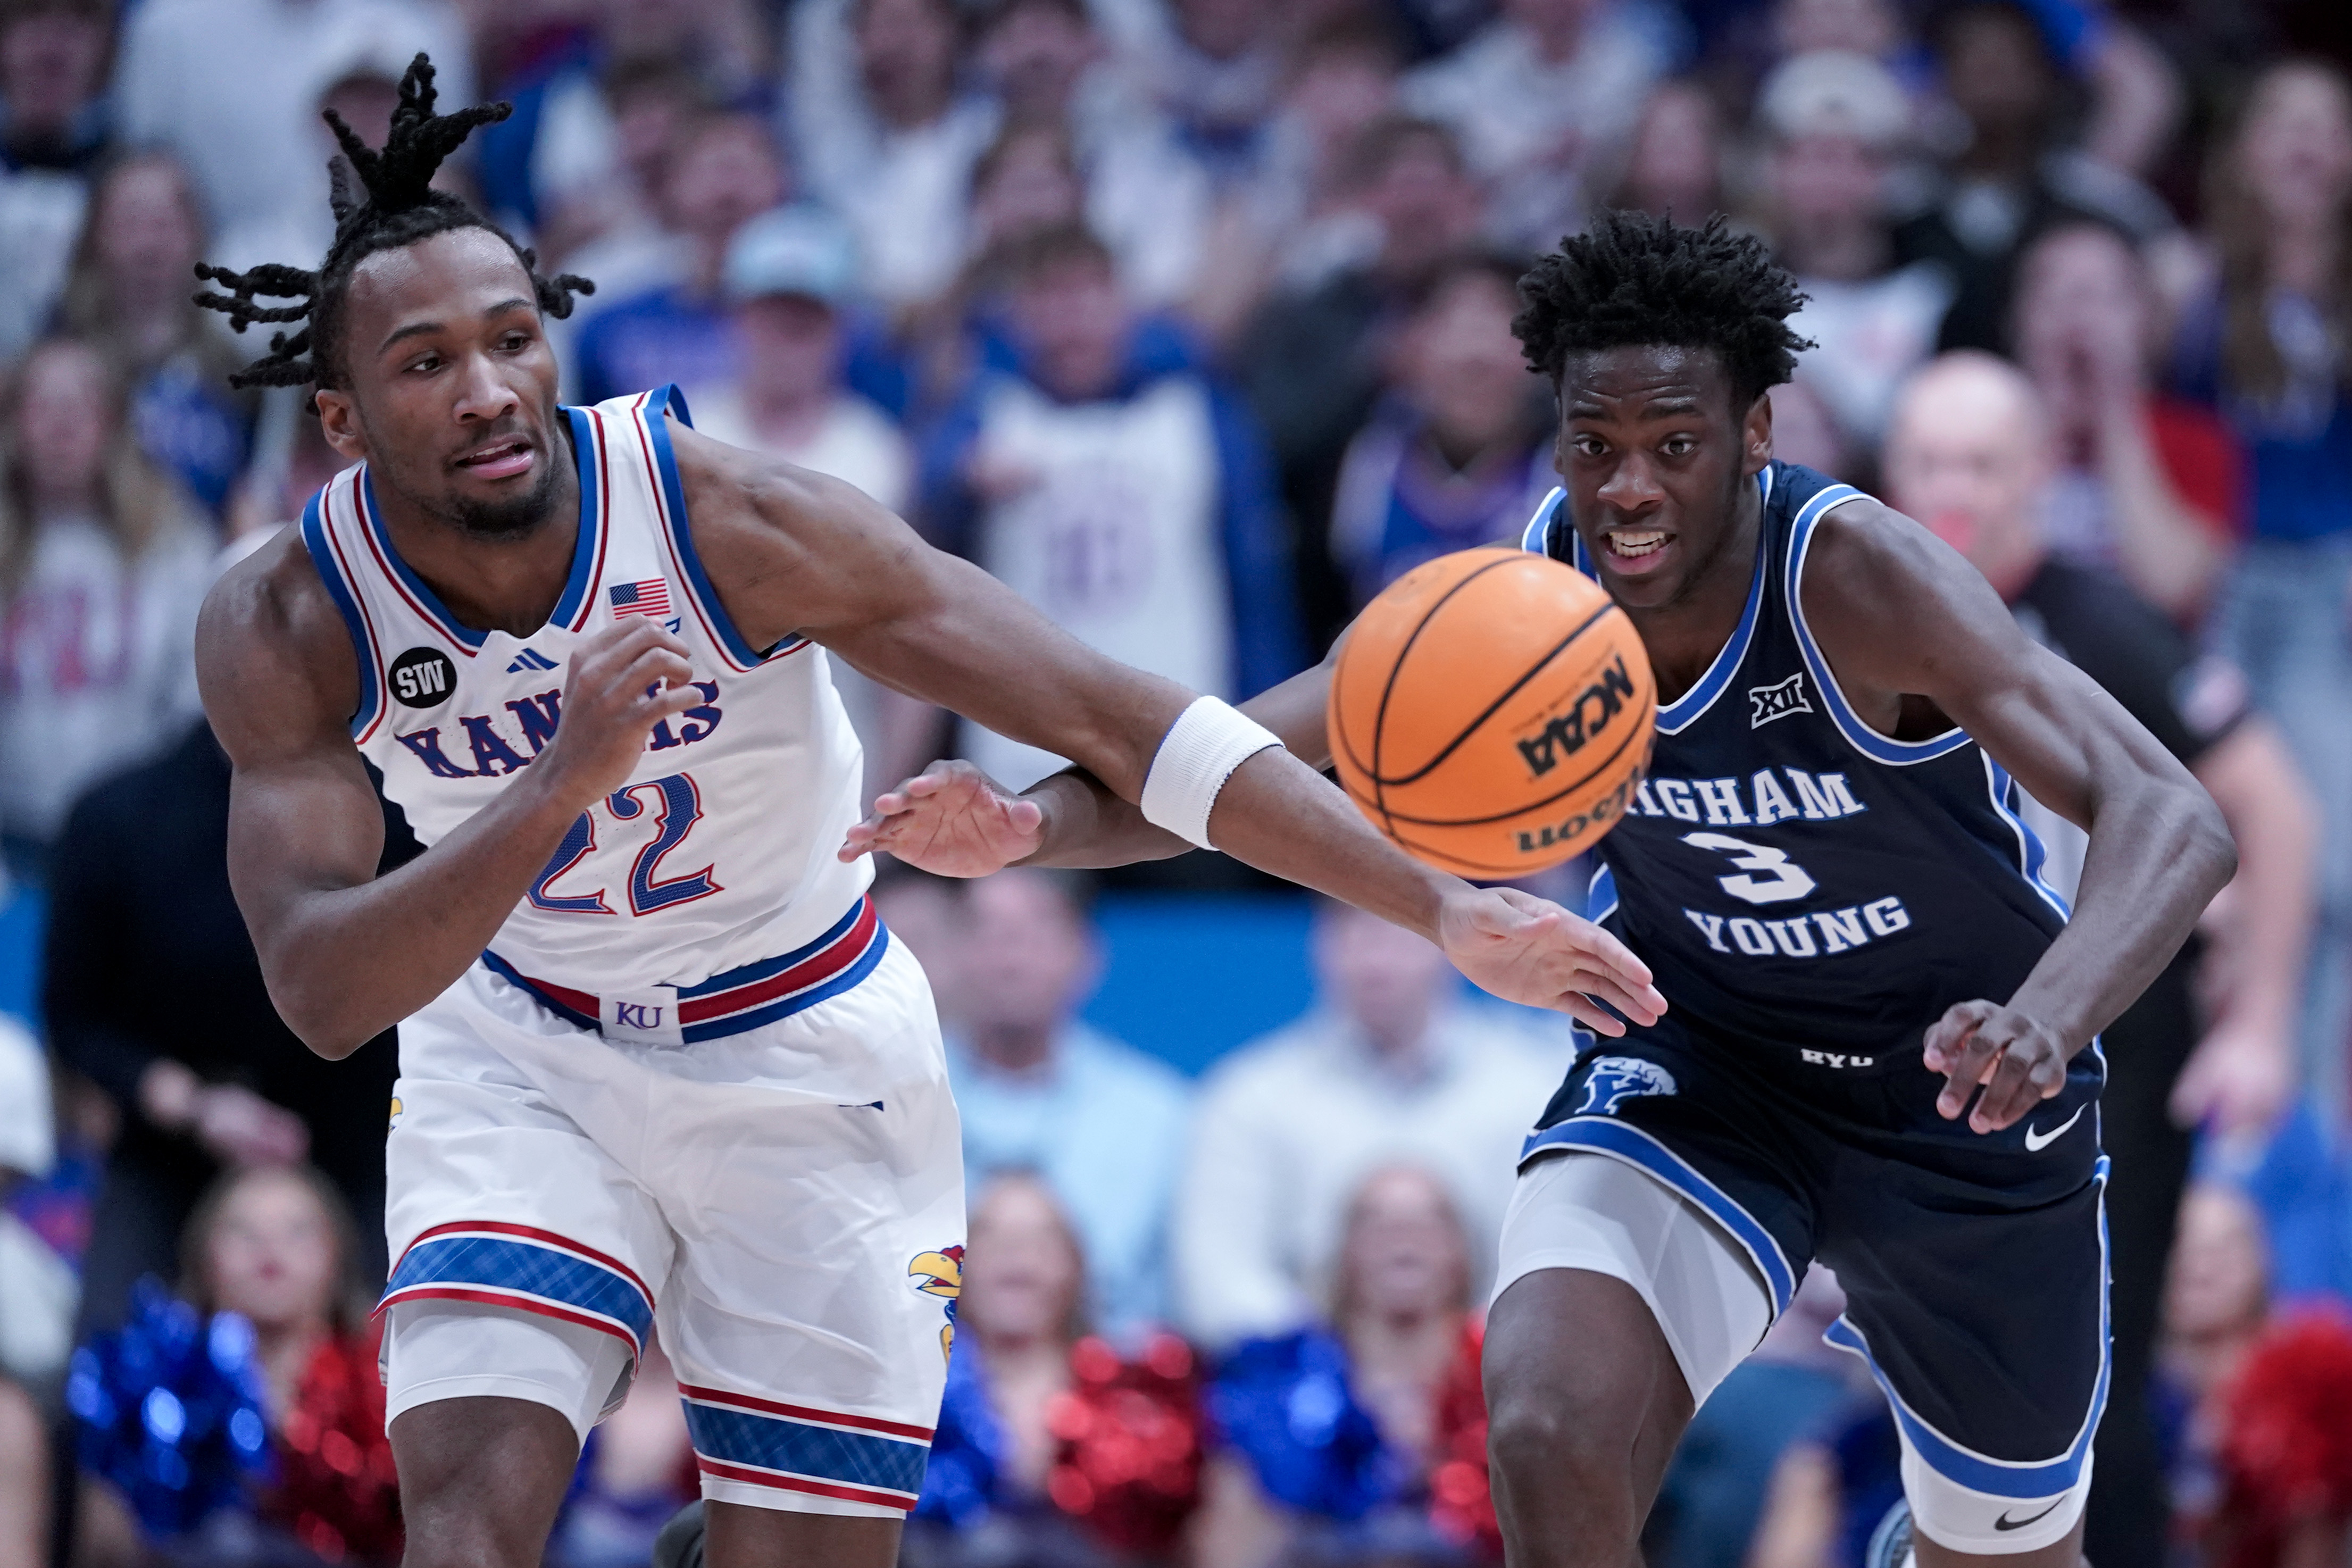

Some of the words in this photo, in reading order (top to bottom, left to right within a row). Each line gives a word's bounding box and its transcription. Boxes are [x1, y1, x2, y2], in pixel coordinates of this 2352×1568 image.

[396, 659, 446, 698] SW
[394, 679, 722, 779] KANS
[1516, 653, 1634, 776] NCAA
[1625, 765, 1869, 827] IGHAM
[525, 772, 725, 918] 22
[1678, 831, 1820, 904] 3
[1683, 895, 1912, 957] YOUNG
[615, 1001, 664, 1030] KU
